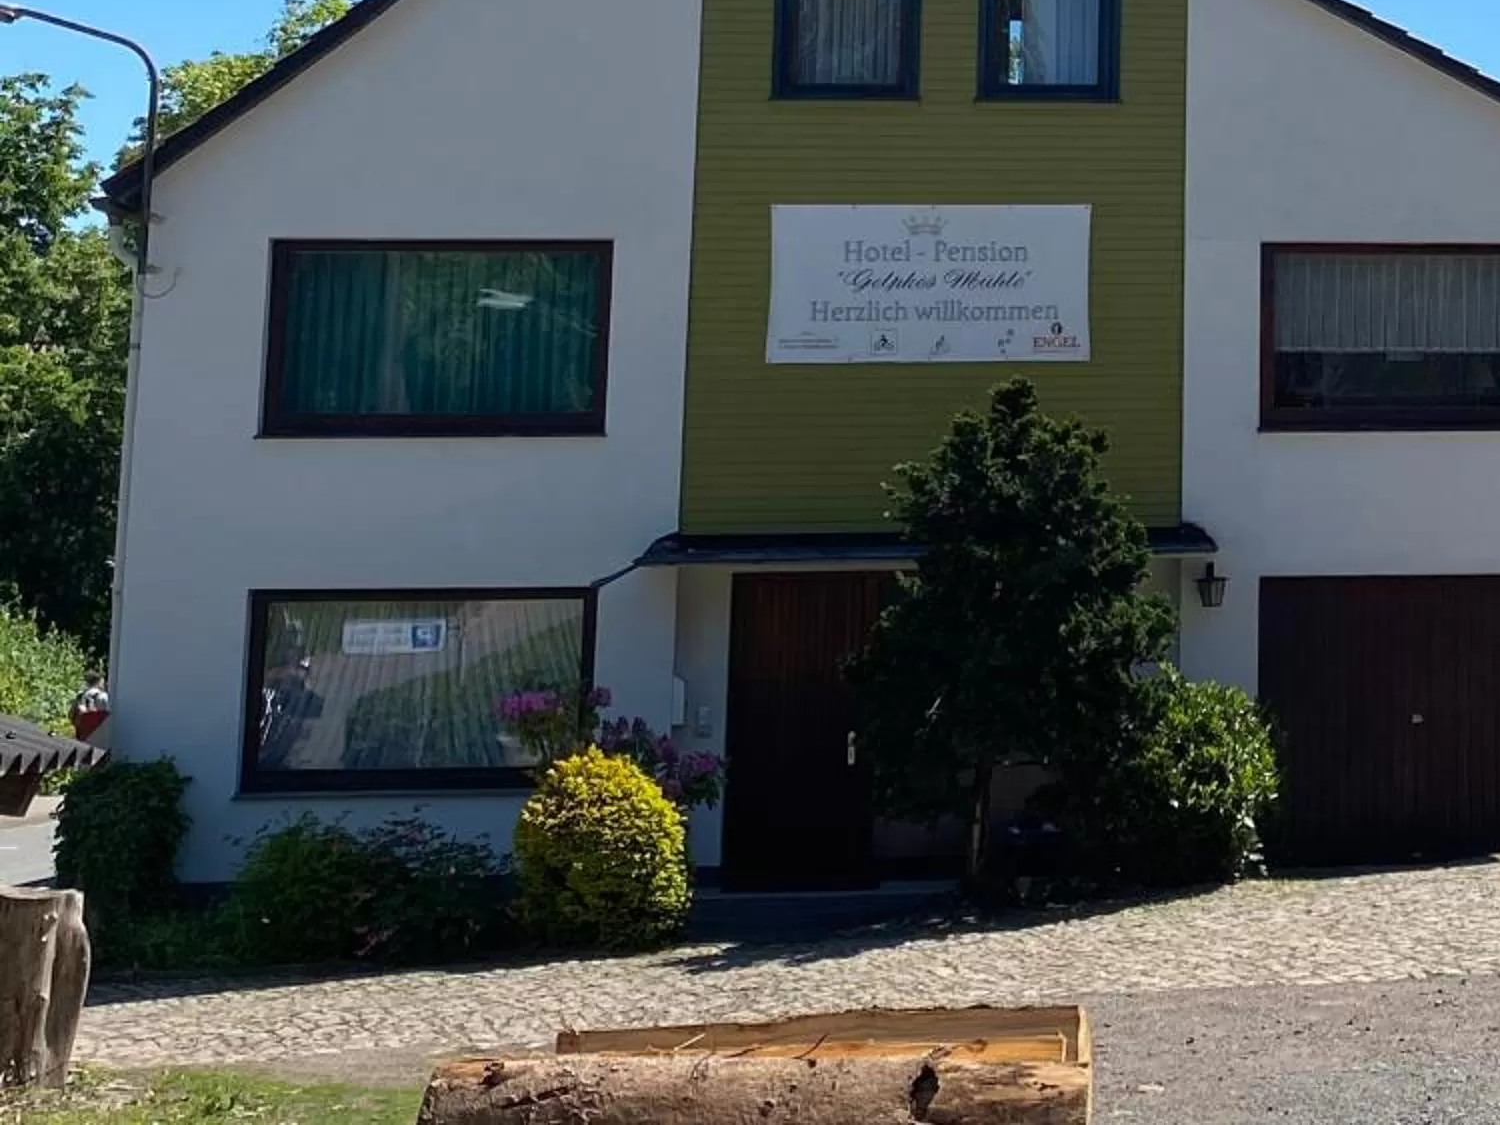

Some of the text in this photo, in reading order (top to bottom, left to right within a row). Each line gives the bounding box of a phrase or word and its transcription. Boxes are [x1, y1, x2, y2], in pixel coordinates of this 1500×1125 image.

[843, 240, 911, 263] Hotel
[933, 240, 1029, 263] Pension
[810, 299, 1060, 323] Herzlich willkommen
[1032, 335, 1082, 348] ENGEL
